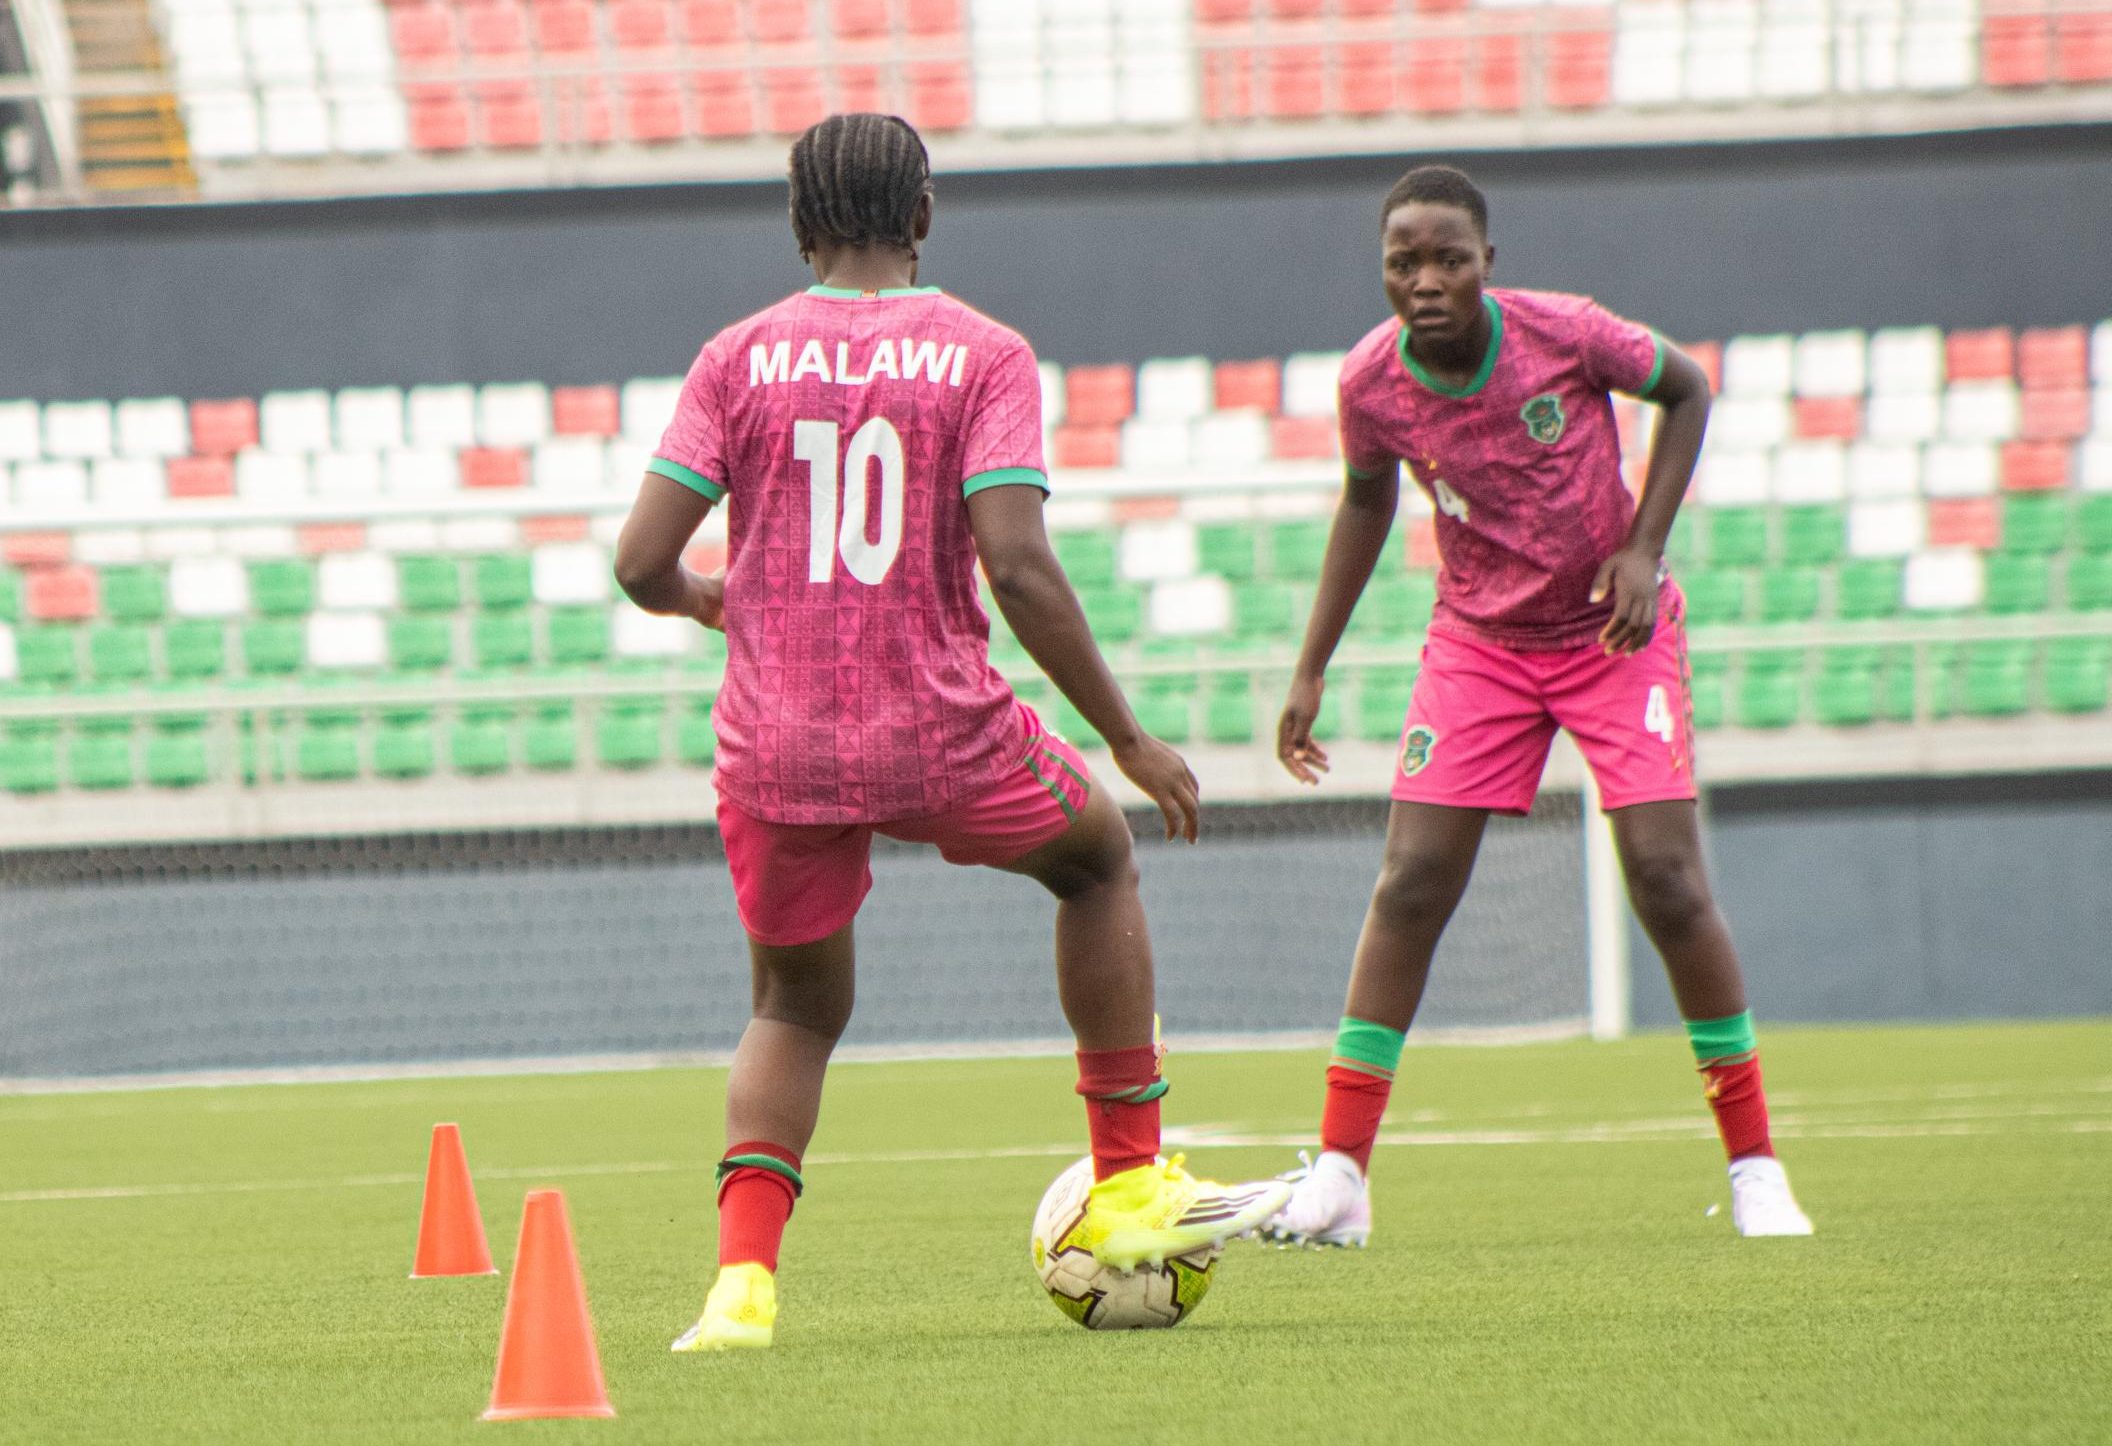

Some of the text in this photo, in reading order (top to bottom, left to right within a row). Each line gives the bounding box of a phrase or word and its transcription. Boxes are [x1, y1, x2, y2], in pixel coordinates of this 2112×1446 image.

[749, 338, 967, 387] MALAWI
[793, 416, 904, 585] 10
[1433, 479, 1469, 523] 4
[1645, 684, 1674, 742] 4
